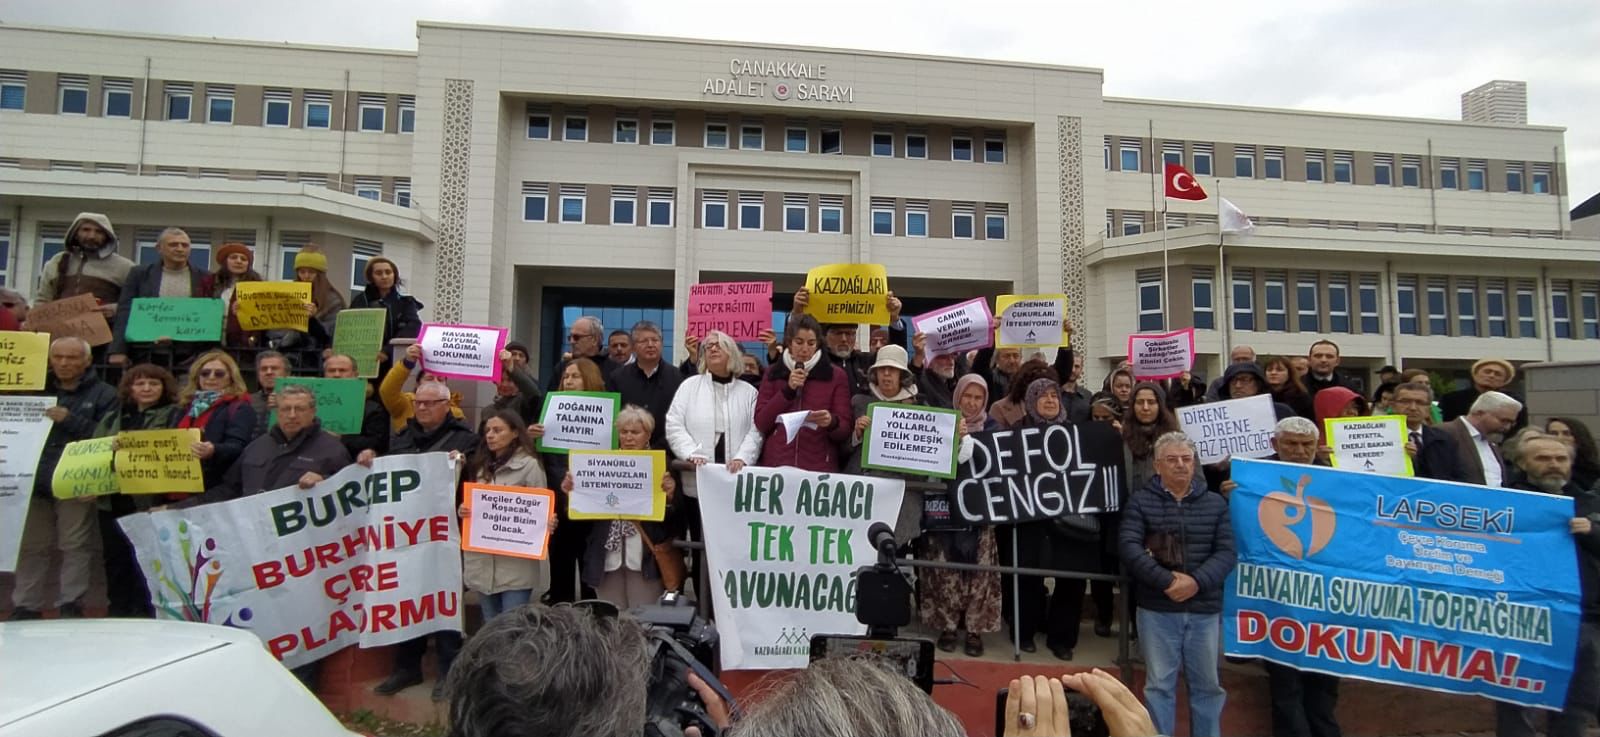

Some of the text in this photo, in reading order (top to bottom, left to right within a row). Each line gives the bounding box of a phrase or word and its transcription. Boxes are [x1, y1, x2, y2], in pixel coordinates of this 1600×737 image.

[730, 58, 826, 81] ÇANAKKALE
[703, 78, 853, 103] ADALET SARAYI
[727, 283, 768, 295] SUYUMU
[814, 274, 885, 295] KAZDAĞLARI
[698, 299, 755, 313] TOPRAĞIMI
[826, 300, 875, 315] HEPİMİZİN
[937, 309, 966, 323] CANIMI
[1005, 319, 1059, 327] İSTEMİYORUZ!
[441, 337, 481, 346] SUYUMA,
[442, 331, 481, 339] HAVAMA,
[442, 342, 477, 351] DAĞIMA
[433, 350, 482, 361] DOKUNMA!
[558, 401, 603, 413] DOĞANIN
[556, 413, 604, 425] TALANINA
[891, 410, 936, 423] KAZDAĞI
[1183, 406, 1229, 425] DİRENE
[561, 425, 594, 436] HAYIR!
[886, 420, 940, 434] YOLLARLA,
[880, 430, 944, 445] DELİK DEŞİK
[883, 441, 939, 455] EDİLEMEZ?
[969, 424, 1097, 479] DEFOL
[1341, 442, 1365, 450] ENERJİ
[587, 458, 636, 468] SİYANÜRLÜ
[120, 467, 159, 479] vatana
[576, 470, 648, 479] ATIK HAVUZLARI
[581, 481, 643, 490] İSTEMİYORUZ!
[481, 493, 542, 508] Keçiler Özgür
[734, 473, 874, 520] HER AĞACI
[491, 503, 532, 515] Koşacak,
[482, 512, 537, 525] Dağlar Bizim
[492, 524, 525, 535] Olacak.
[747, 521, 853, 565] TEK TEK
[1398, 530, 1487, 553] Çevre Koruma
[1455, 553, 1473, 564] ve
[1385, 554, 1505, 584] Dayanışma Derneği
[1237, 563, 1552, 645] HAVAMA SUYUMA TOPRAĞIMA
